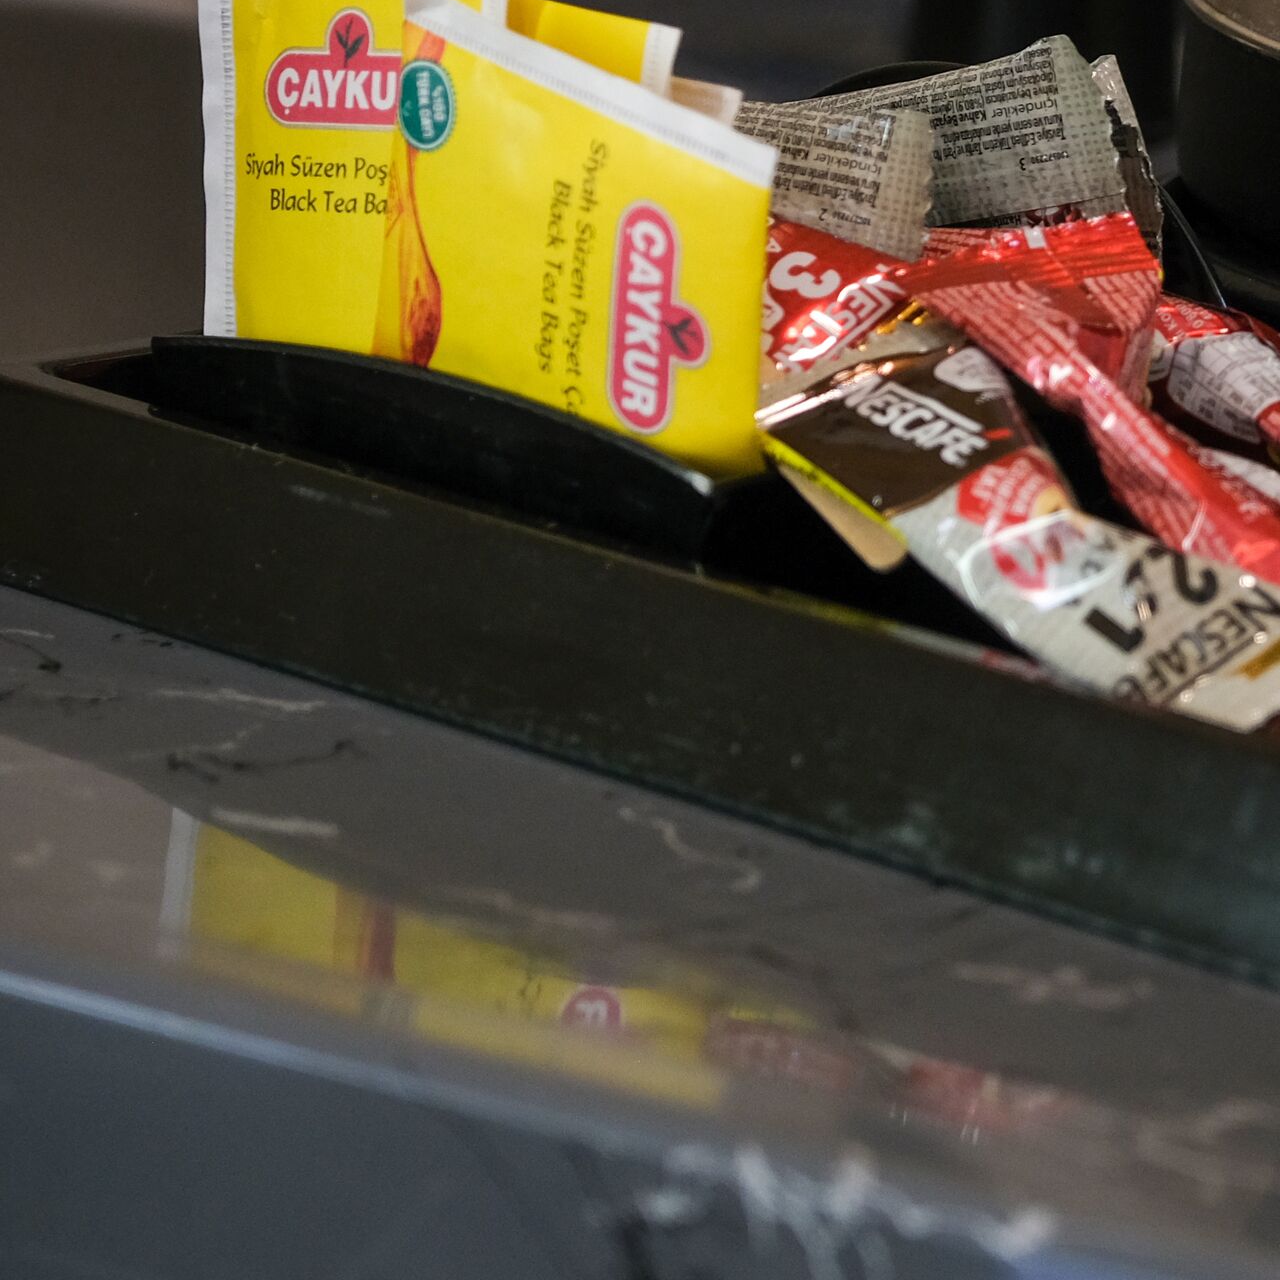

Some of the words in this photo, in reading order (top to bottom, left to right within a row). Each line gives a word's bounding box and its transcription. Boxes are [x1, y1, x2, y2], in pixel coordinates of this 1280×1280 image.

[277, 69, 397, 115] ÇAYKU
[958, 110, 985, 124] Kahve
[246, 153, 285, 180] Siyah
[290, 154, 347, 179] Süzen
[354, 157, 388, 186] Poş
[576, 137, 610, 215] Siyah
[270, 188, 317, 213] Black
[323, 190, 357, 214] Tea
[364, 192, 388, 215] Ba
[552, 179, 572, 248] Black
[541, 253, 563, 301] Tea
[566, 218, 595, 300] Süzen
[535, 309, 557, 374] Bags
[558, 305, 590, 377] Poşet
[622, 223, 667, 419] ÇAYKUR
[557, 384, 587, 415] Ça
